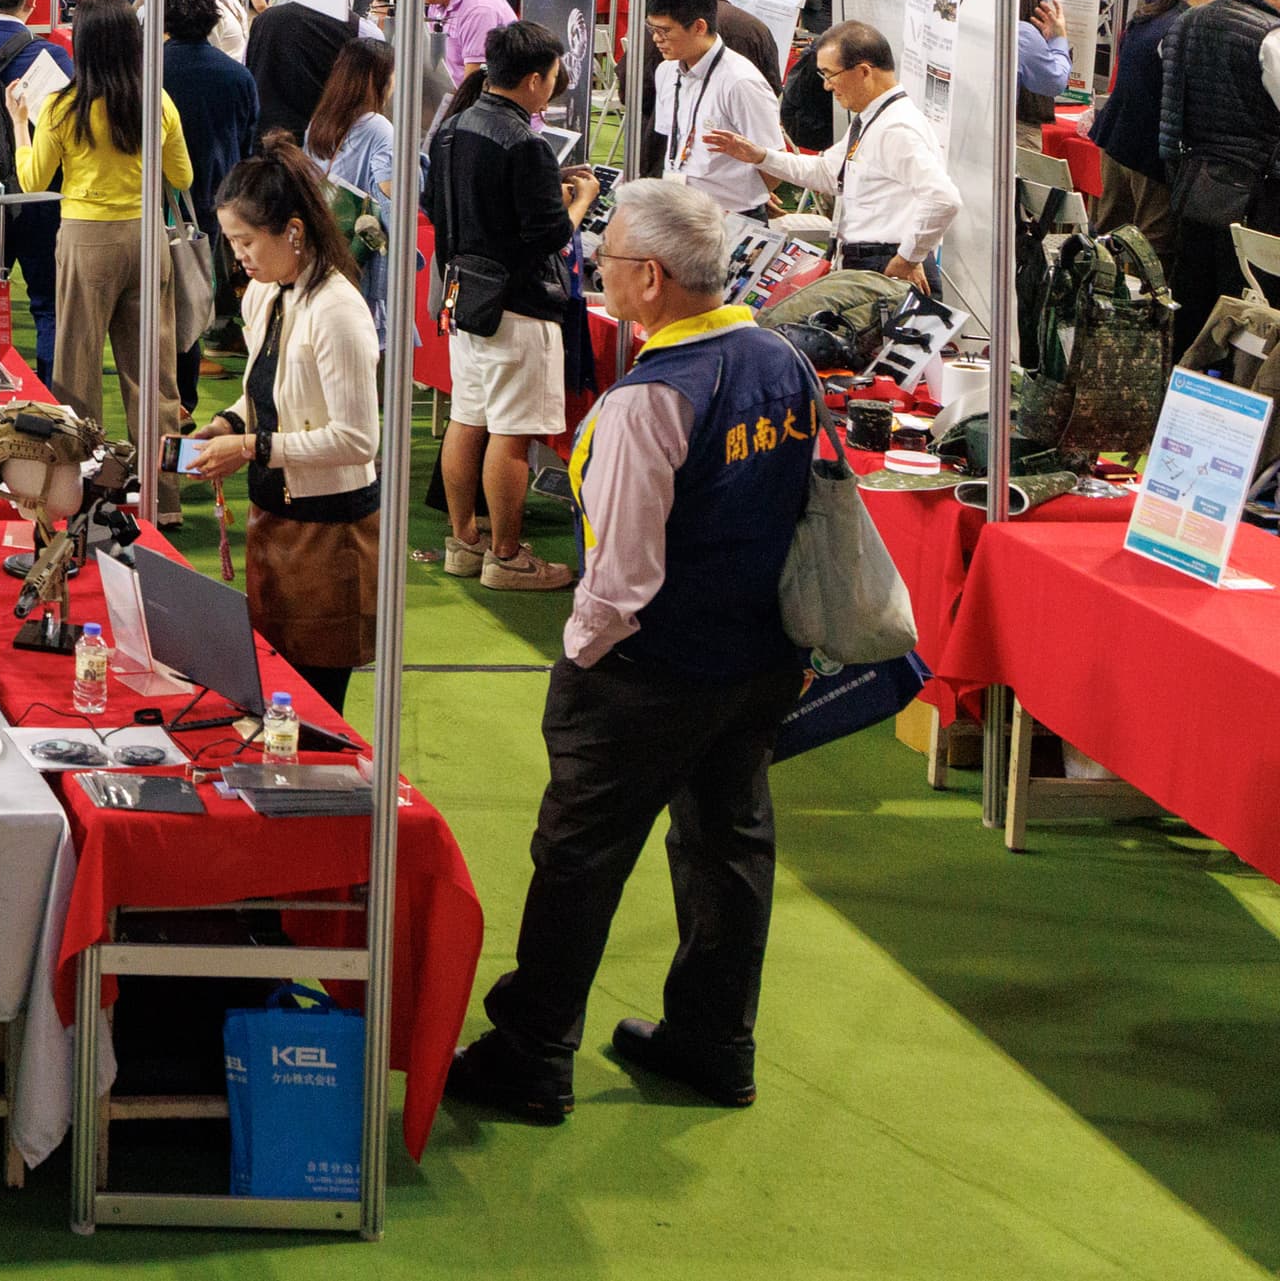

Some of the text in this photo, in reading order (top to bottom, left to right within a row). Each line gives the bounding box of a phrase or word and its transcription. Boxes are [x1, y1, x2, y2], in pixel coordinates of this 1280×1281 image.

[725, 399, 817, 465] 開南大
[225, 1055, 247, 1072] EL
[272, 1045, 337, 1069] KEL
[272, 1073, 337, 1087] ケル株式会社
